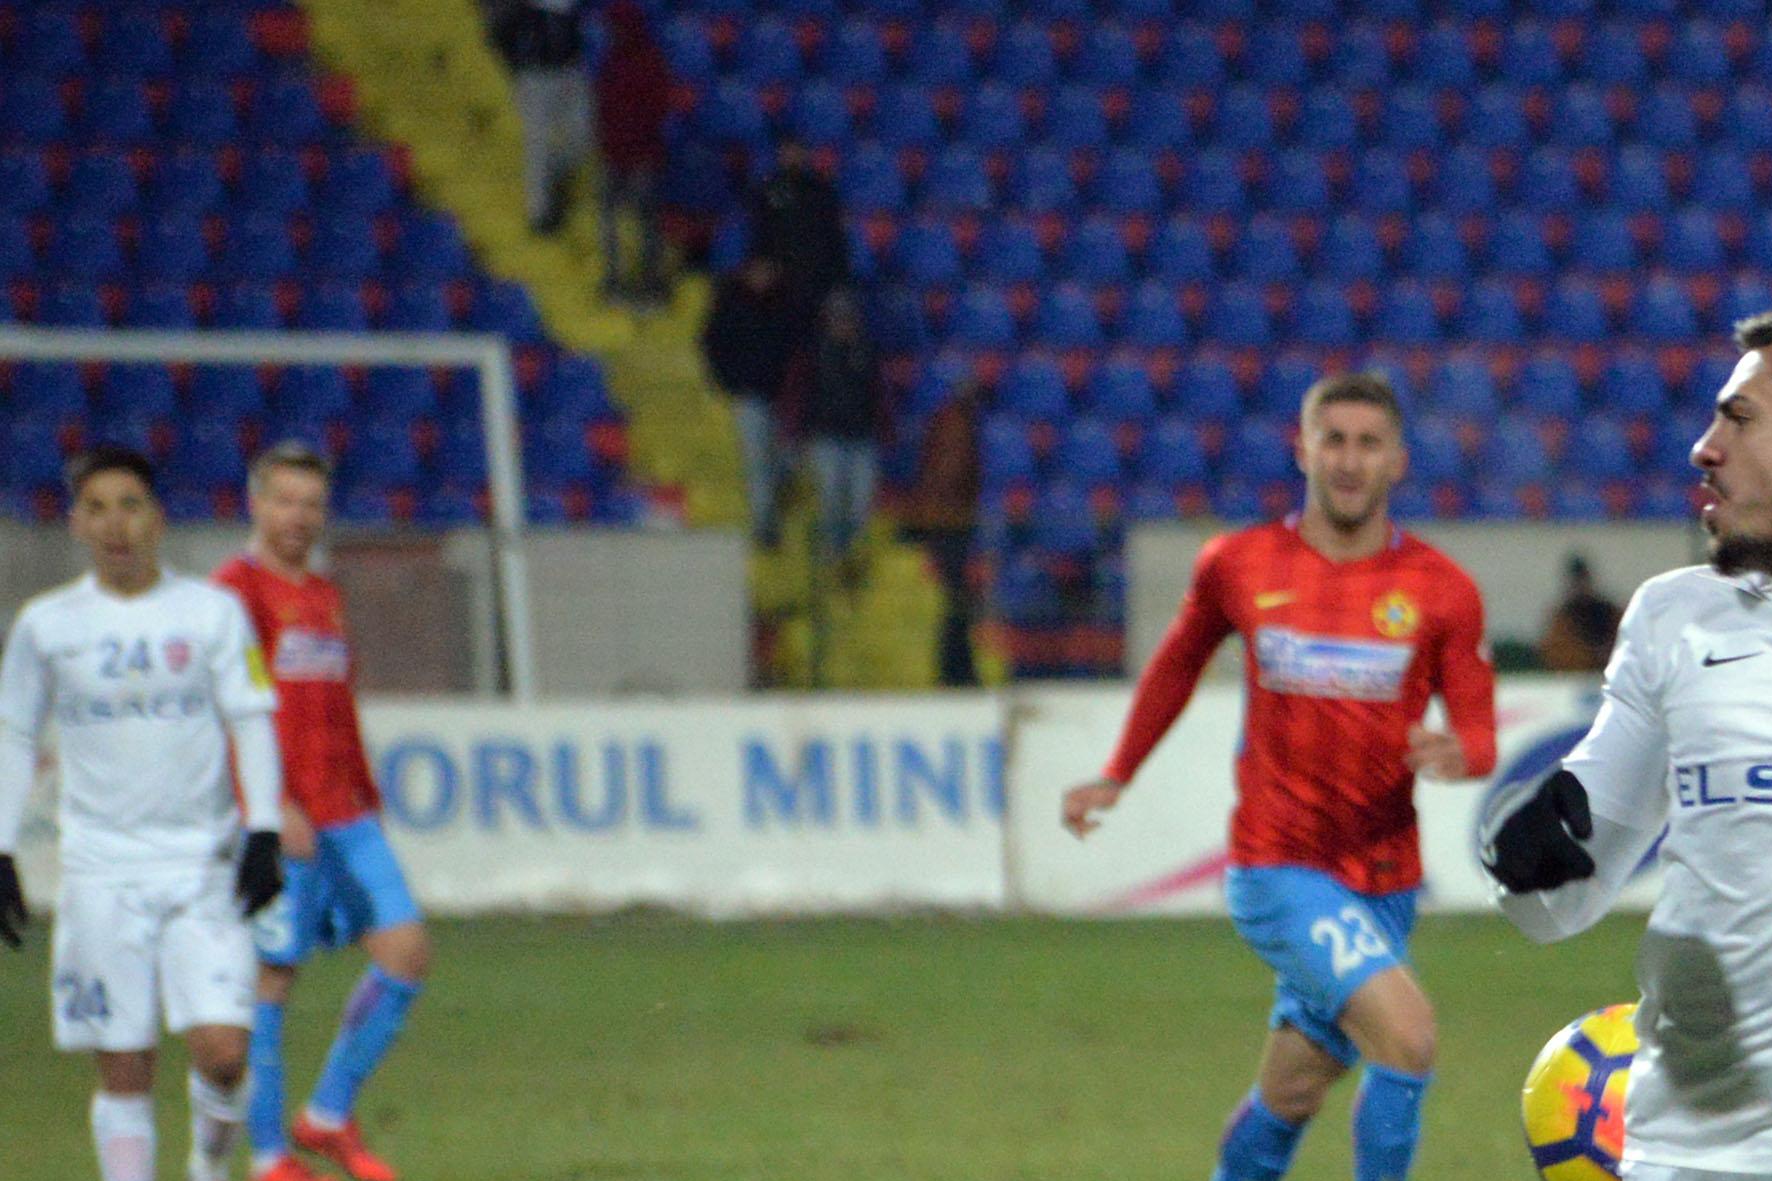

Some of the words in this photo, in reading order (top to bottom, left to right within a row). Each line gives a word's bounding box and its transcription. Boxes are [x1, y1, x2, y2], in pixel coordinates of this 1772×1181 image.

[99, 635, 152, 679] 24
[377, 735, 698, 833] ORUL
[55, 968, 112, 1023] 24
